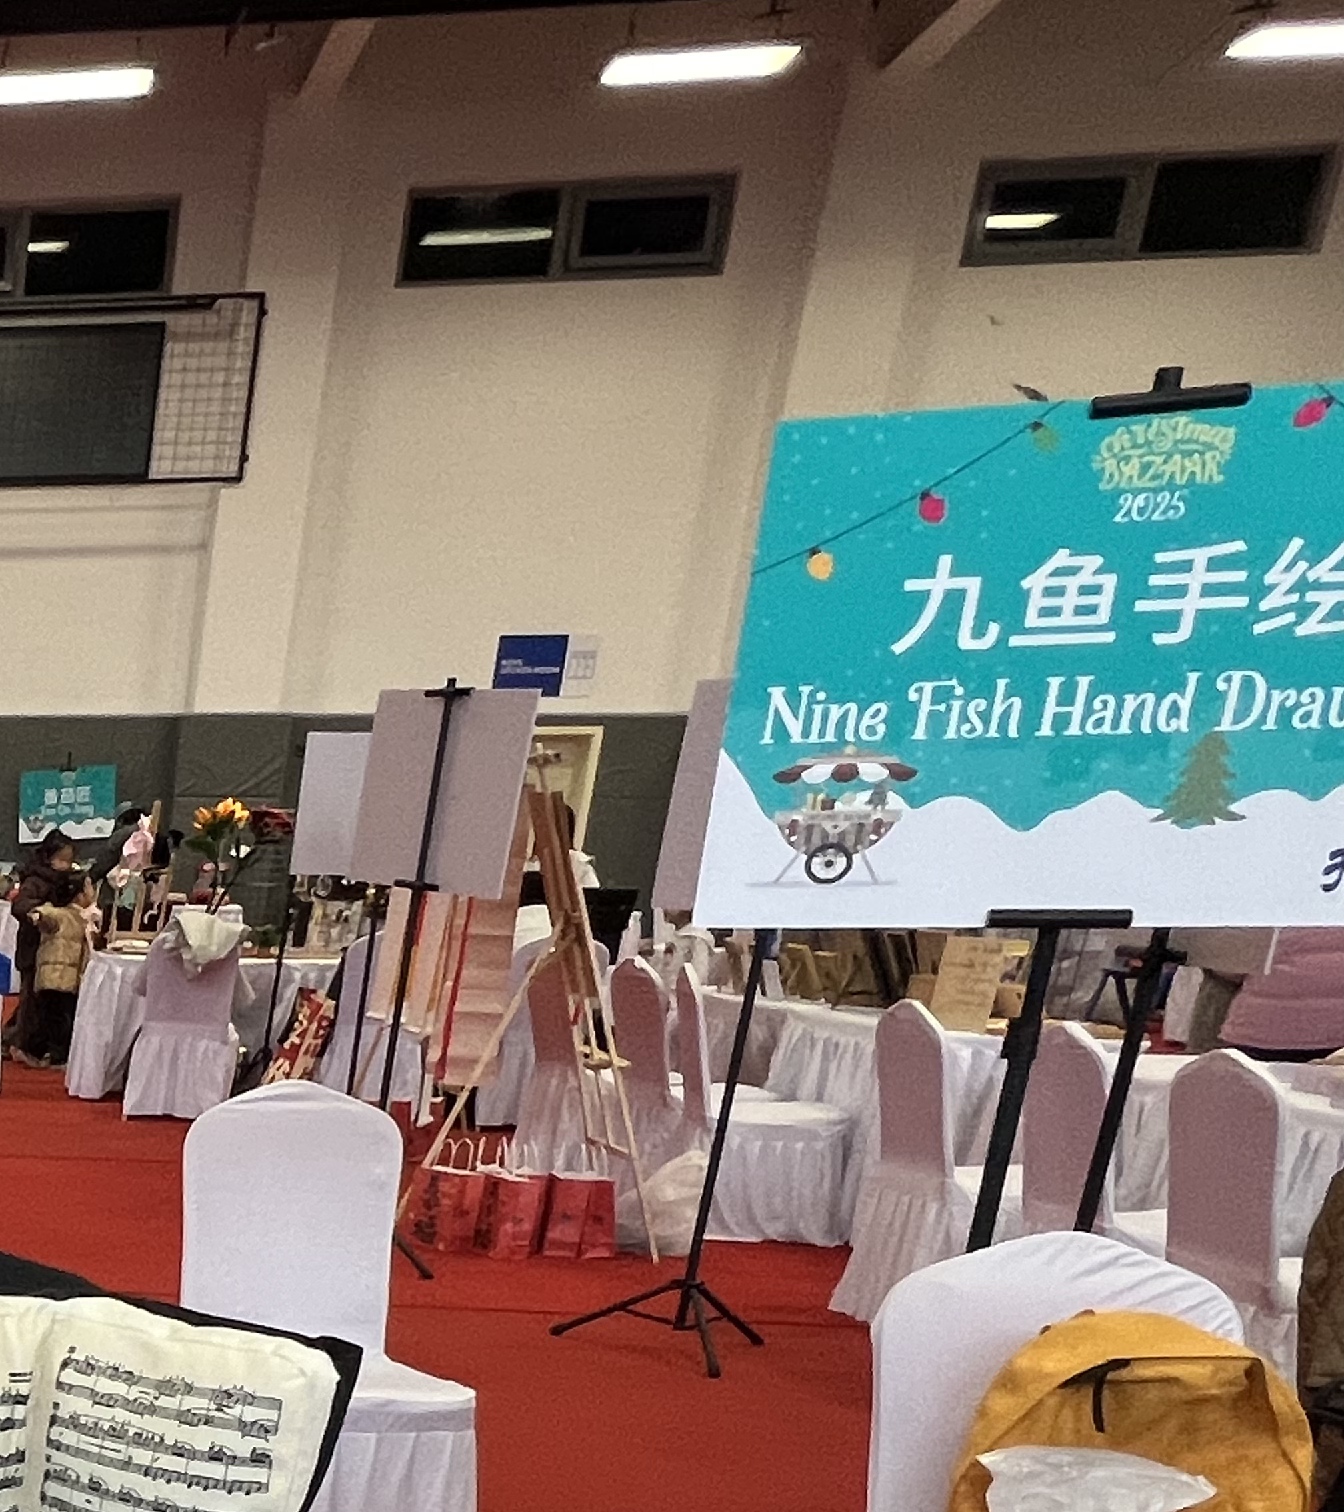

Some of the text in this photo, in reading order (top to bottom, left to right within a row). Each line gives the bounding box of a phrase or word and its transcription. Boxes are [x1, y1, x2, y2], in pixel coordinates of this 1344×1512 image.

[1112, 489, 1187, 523] 2025
[890, 537, 1344, 656] 九鱼手绘
[760, 685, 888, 745] Nine
[906, 676, 1021, 742] Fish
[1035, 671, 1203, 737] Hand
